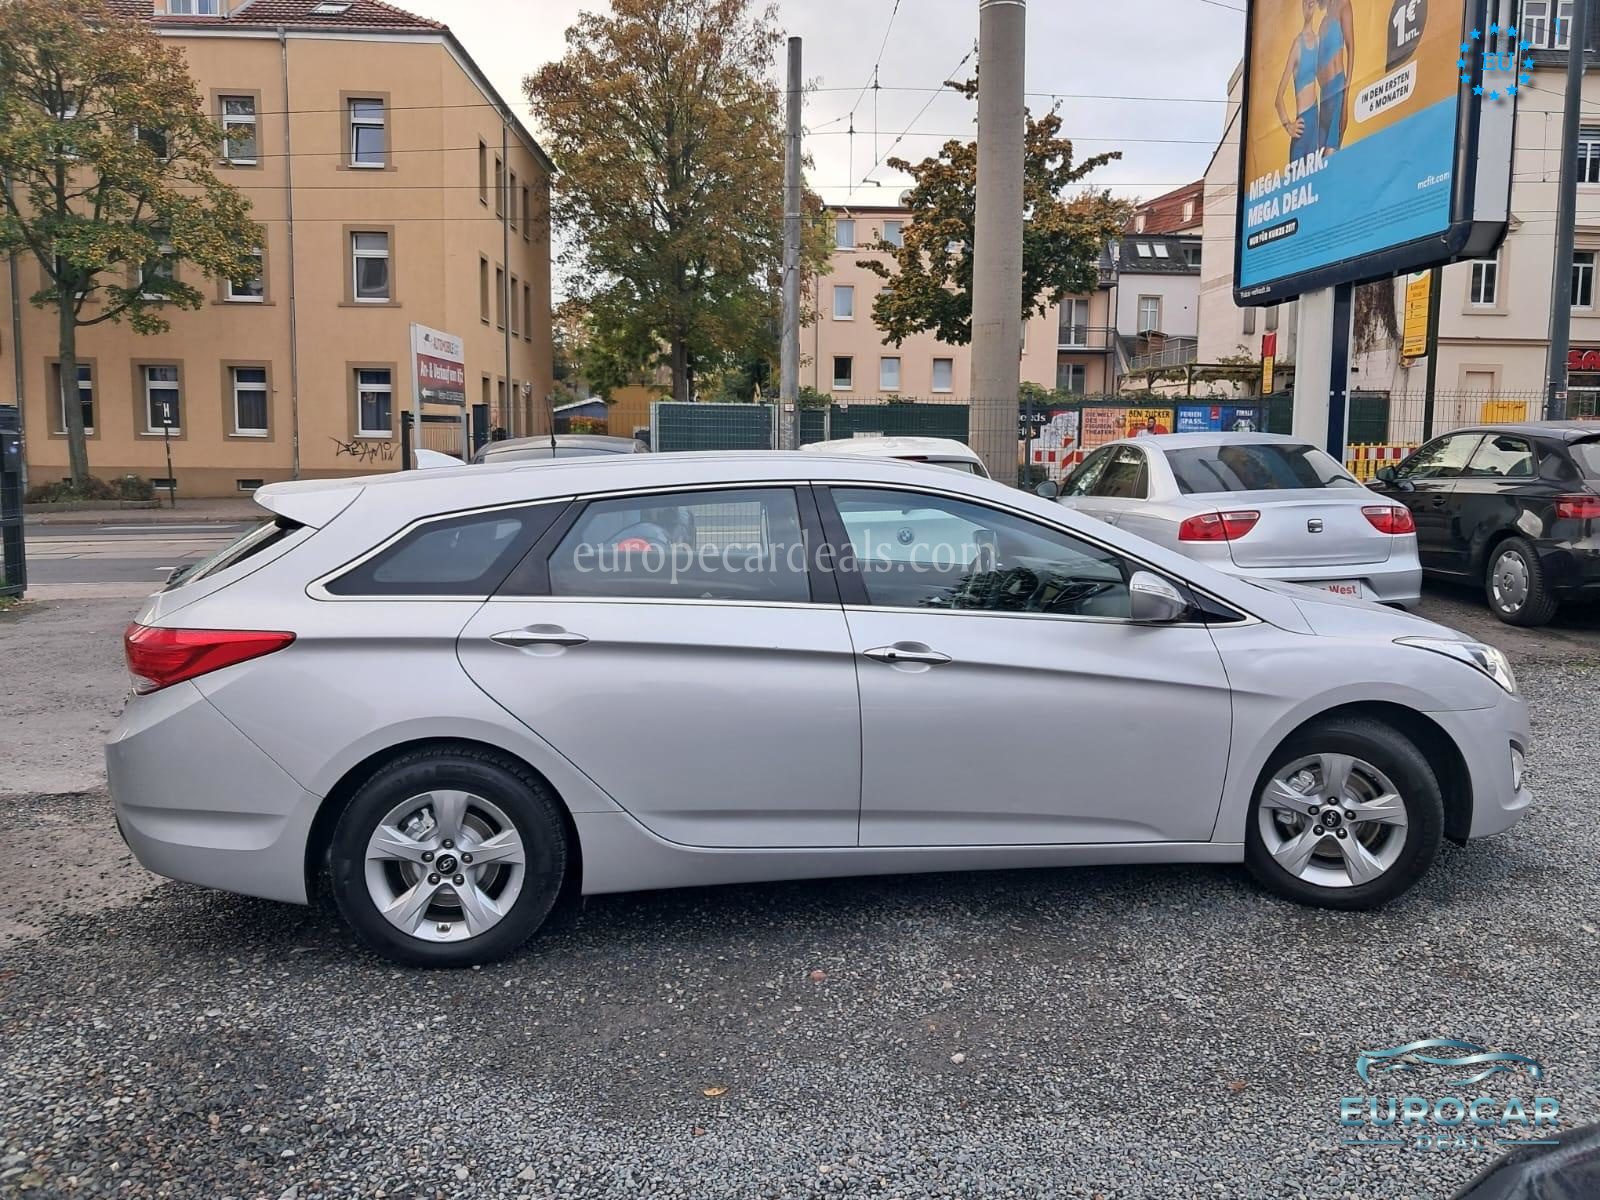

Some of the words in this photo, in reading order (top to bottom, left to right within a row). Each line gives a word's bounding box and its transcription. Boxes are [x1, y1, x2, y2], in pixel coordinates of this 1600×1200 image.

[1405, 28, 1420, 41] MTL.
[1361, 93, 1369, 104] IN
[1370, 86, 1384, 100] DEN
[1385, 71, 1410, 91] ERSTEN
[1369, 103, 1374, 112] 6
[1375, 85, 1409, 109] MONATEN
[1249, 168, 1281, 202] MEGA
[1283, 148, 1329, 187] STARK.
[1417, 171, 1450, 190] mcfit.com
[1248, 197, 1280, 228] MEGA
[1282, 182, 1319, 215] DEAL.
[1567, 349, 1600, 370] SA
[1128, 410, 1142, 418] BEN
[1329, 584, 1357, 595] West
